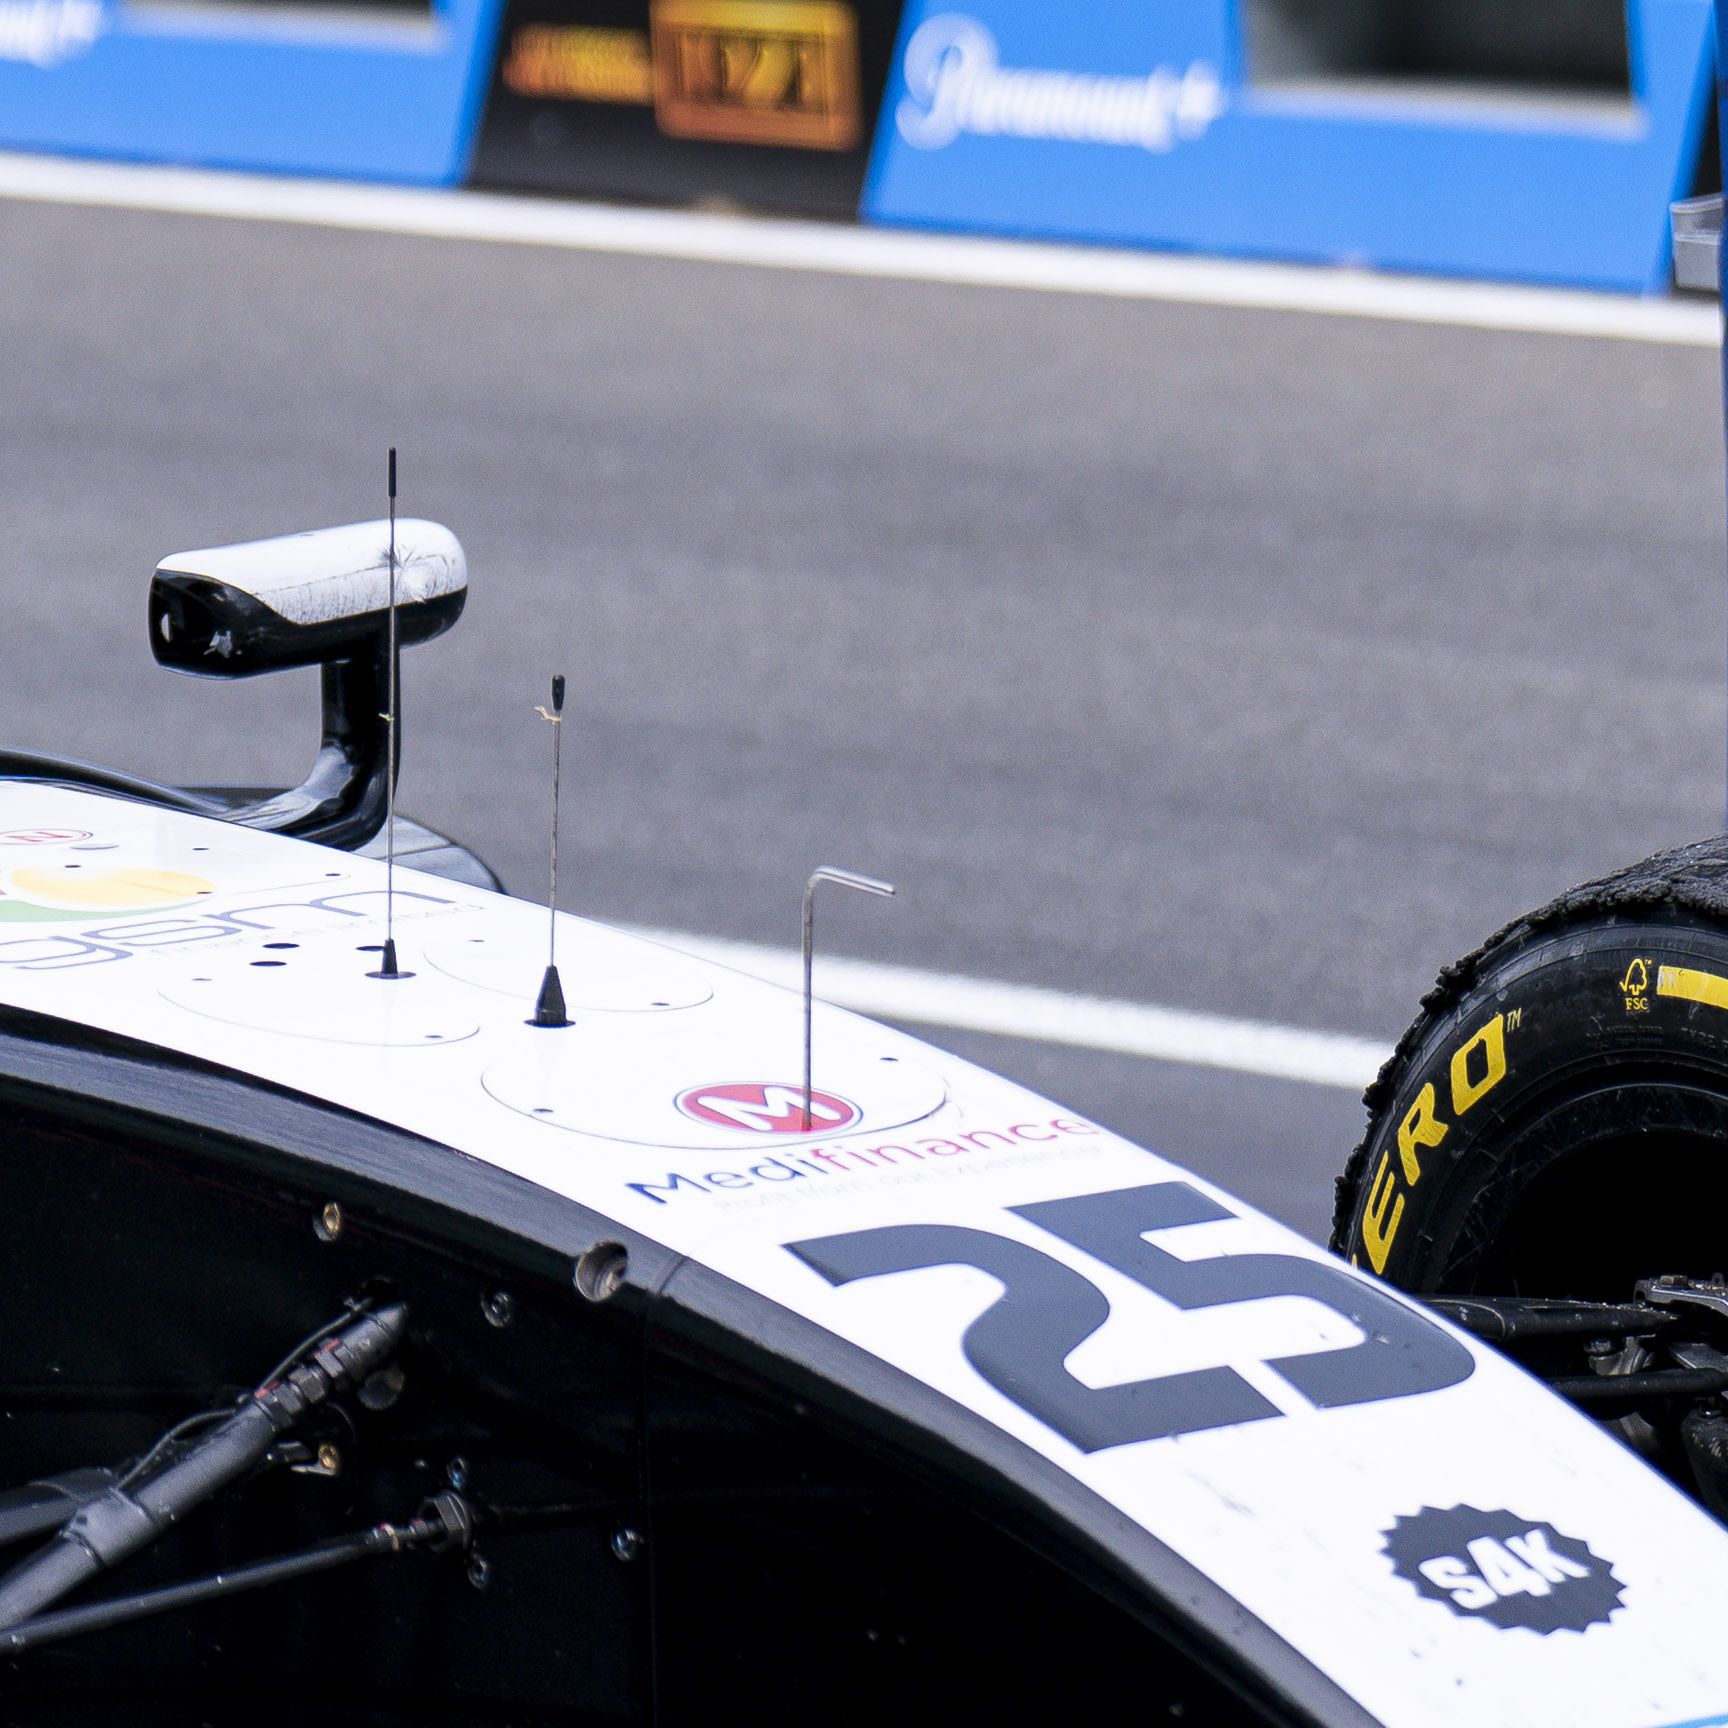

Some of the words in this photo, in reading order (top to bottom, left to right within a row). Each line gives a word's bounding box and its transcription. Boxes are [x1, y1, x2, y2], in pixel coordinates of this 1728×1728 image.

[1625, 997, 1648, 1011] FSC
[624, 1116, 1102, 1206] Medifinance
[782, 1179, 1477, 1454] 25
[1418, 1527, 1591, 1613] S4K
